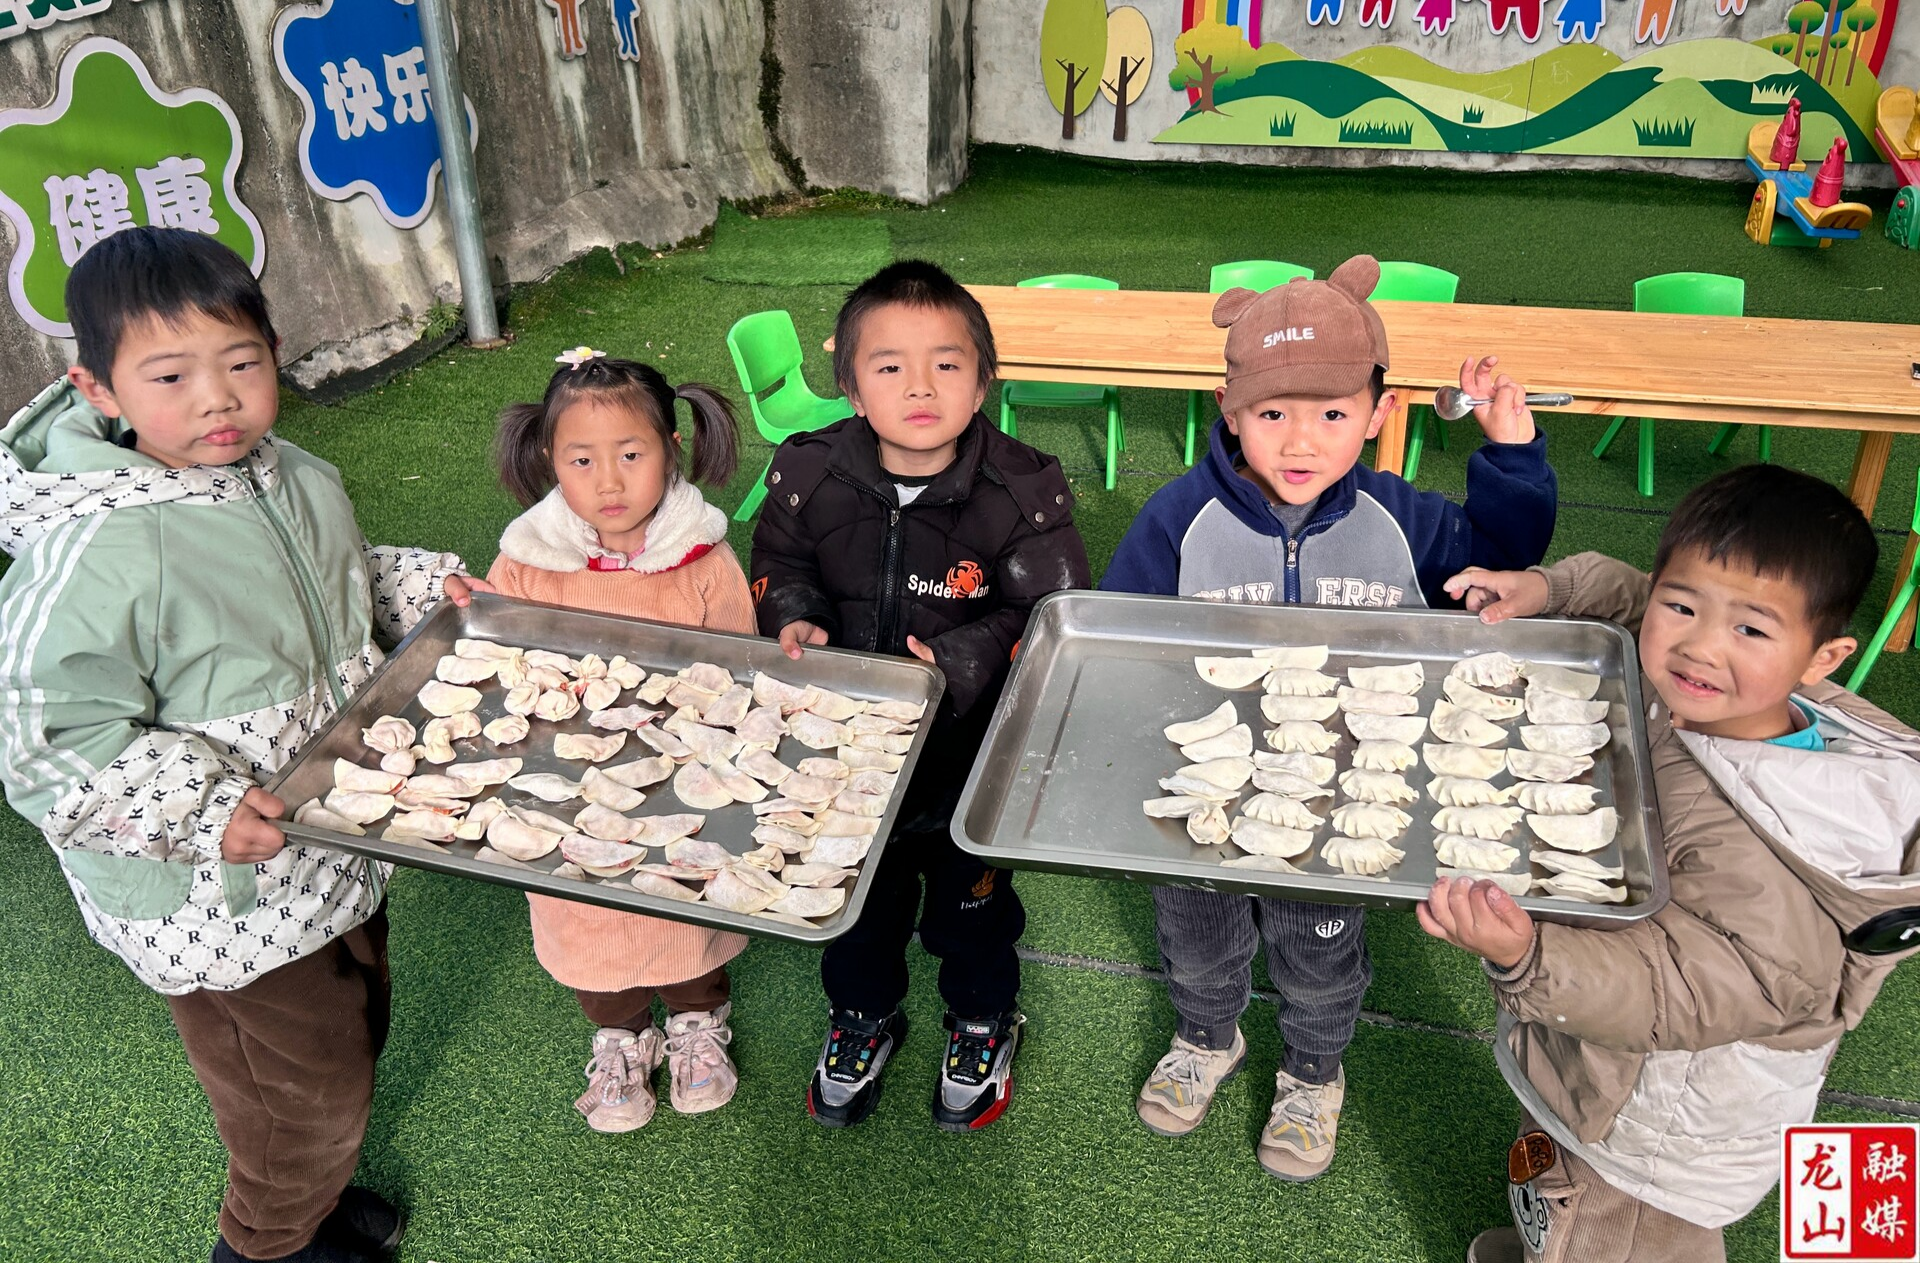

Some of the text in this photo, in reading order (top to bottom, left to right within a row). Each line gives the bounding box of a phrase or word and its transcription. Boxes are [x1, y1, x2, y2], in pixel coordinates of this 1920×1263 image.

[320, 46, 433, 141] 快乐
[43, 156, 220, 268] 健康
[1262, 327, 1315, 348] SMILE
[165, 467, 179, 479] R
[134, 483, 150, 493] R
[213, 479, 226, 490] R
[36, 488, 50, 496] R
[10, 502, 25, 511] R
[100, 498, 118, 511] R
[378, 596, 391, 606] R
[407, 596, 415, 605] R
[390, 613, 400, 623] R
[363, 656, 372, 668] R
[339, 674, 350, 686] R
[322, 701, 332, 715] R
[284, 708, 295, 722] R
[239, 722, 254, 734] R
[268, 736, 278, 749] R
[146, 749, 162, 759] R
[180, 754, 199, 765] R
[111, 759, 129, 771] R
[250, 761, 264, 773] R
[185, 778, 204, 792] R
[123, 787, 139, 798] R
[152, 790, 167, 802] R
[213, 796, 231, 806] R
[198, 824, 213, 834] R
[147, 831, 163, 843] R
[297, 847, 307, 861] R
[252, 860, 268, 875] R
[332, 863, 344, 877] R
[200, 871, 213, 881] R
[280, 876, 291, 887] R
[344, 869, 354, 882] R
[301, 884, 311, 895] R
[320, 892, 331, 904] R
[207, 907, 220, 920] R
[279, 907, 293, 920] R
[119, 924, 130, 935] R
[235, 921, 248, 934] R
[323, 925, 335, 939] R
[145, 936, 157, 948] R
[188, 931, 201, 943] R
[262, 935, 275, 947] R
[215, 947, 229, 960] R
[286, 945, 300, 958] R
[170, 955, 182, 966] R
[243, 961, 256, 973] R
[196, 972, 209, 982] R
